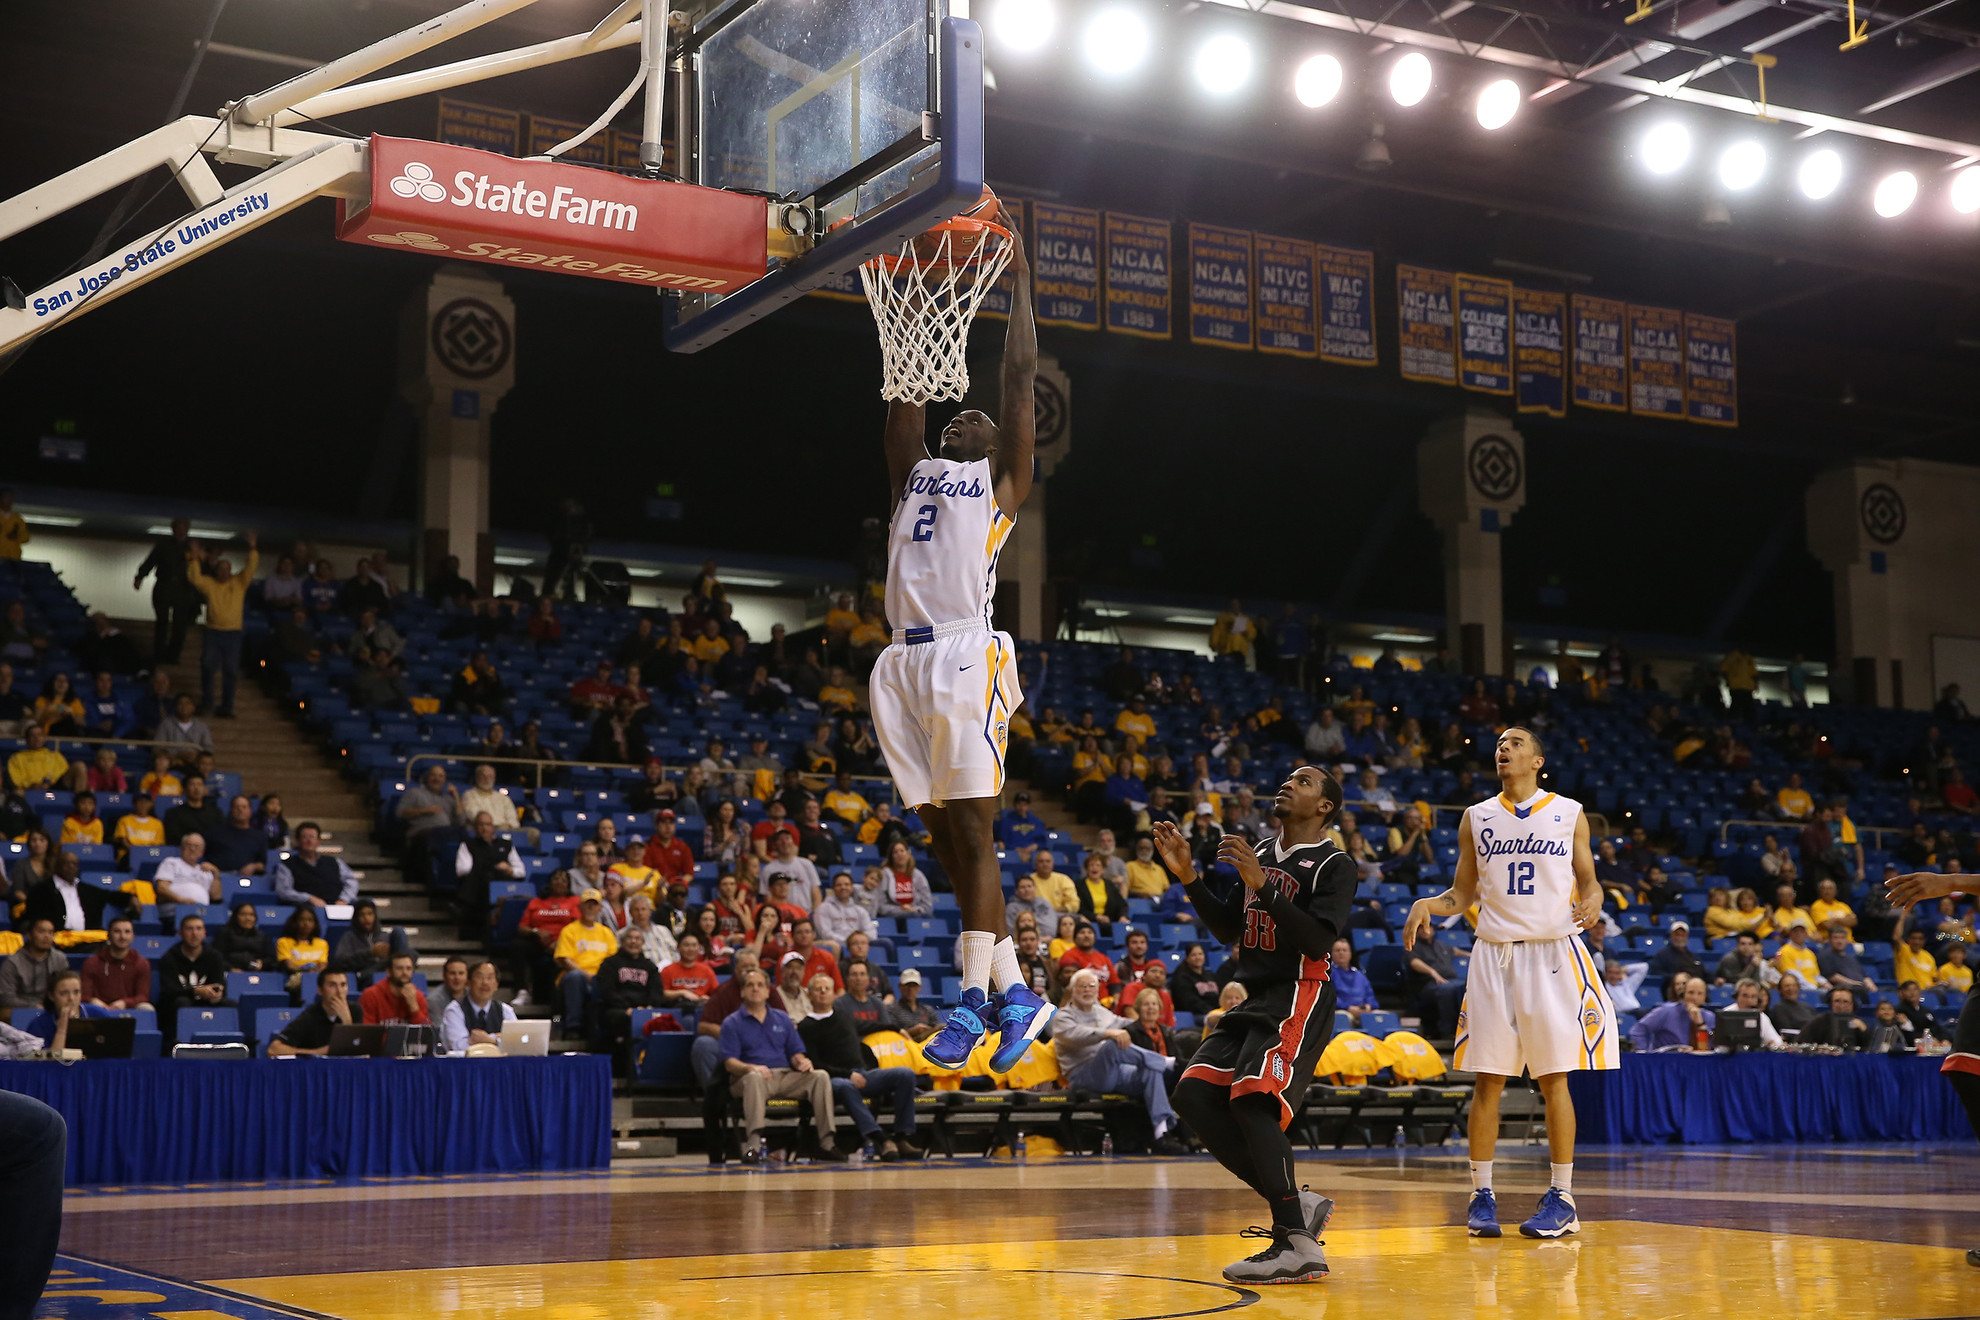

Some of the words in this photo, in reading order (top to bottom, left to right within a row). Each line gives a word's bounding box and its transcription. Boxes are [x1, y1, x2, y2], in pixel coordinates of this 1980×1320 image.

[33, 291, 73, 317] San
[77, 266, 122, 297] Jose
[124, 240, 176, 272] State
[178, 192, 269, 245] University
[1039, 239, 1094, 265] NCAA
[1111, 247, 1165, 272] NCAA
[1195, 261, 1247, 287] NCAA
[1263, 265, 1308, 289] NIVC
[1328, 274, 1363, 297] WAC
[1402, 289, 1450, 312] NCAA
[1329, 310, 1362, 327] WEST
[1515, 312, 1561, 335] NCAA
[1578, 319, 1620, 340] AIAW
[1464, 337, 1505, 355] SERIES
[1633, 328, 1680, 350] NCAA
[1688, 341, 1732, 364] NCAA
[912, 504, 938, 542] 2
[1478, 828, 1568, 864] Spartans
[1506, 861, 1535, 895] 12
[1243, 908, 1277, 952] 33
